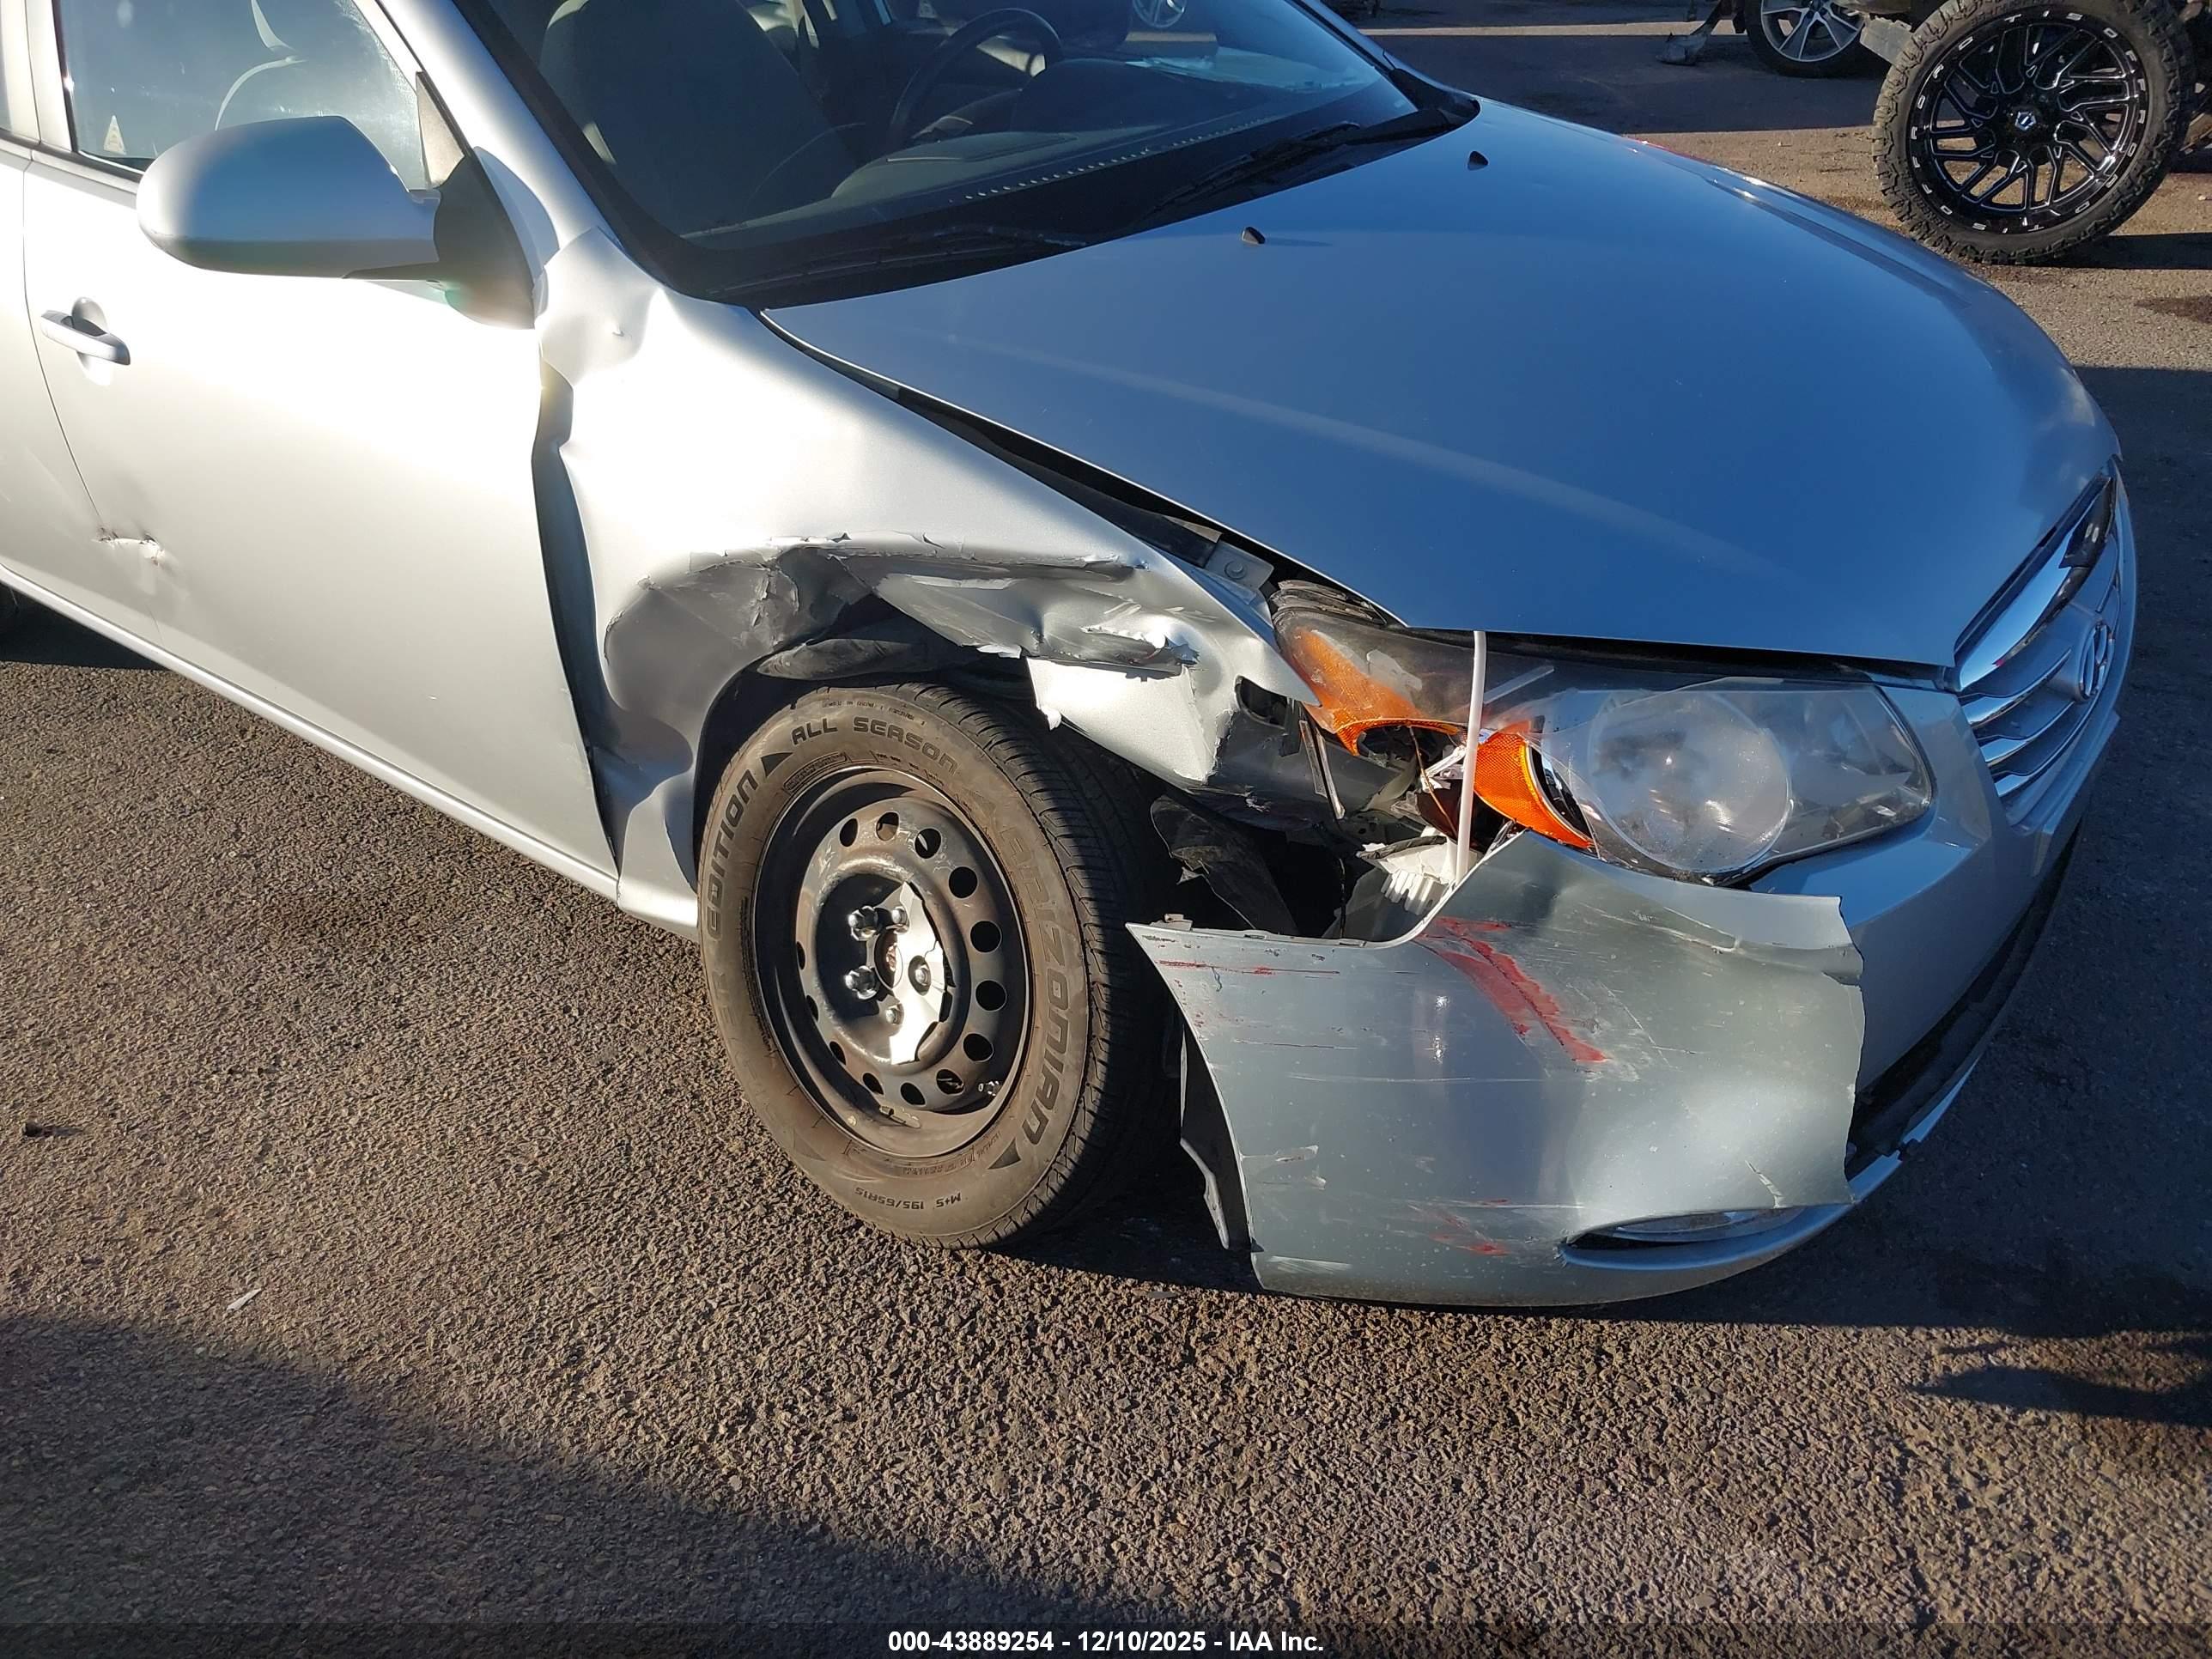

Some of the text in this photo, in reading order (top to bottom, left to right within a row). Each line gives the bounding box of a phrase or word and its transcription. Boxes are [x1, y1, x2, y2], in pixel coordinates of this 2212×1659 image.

[791, 718, 838, 745] ALL
[853, 716, 958, 775] SEASON
[707, 769, 759, 940] EDITION
[999, 826, 1070, 1146] ARIZONIAN
[854, 1187, 962, 1210] M+S 195/65R15
